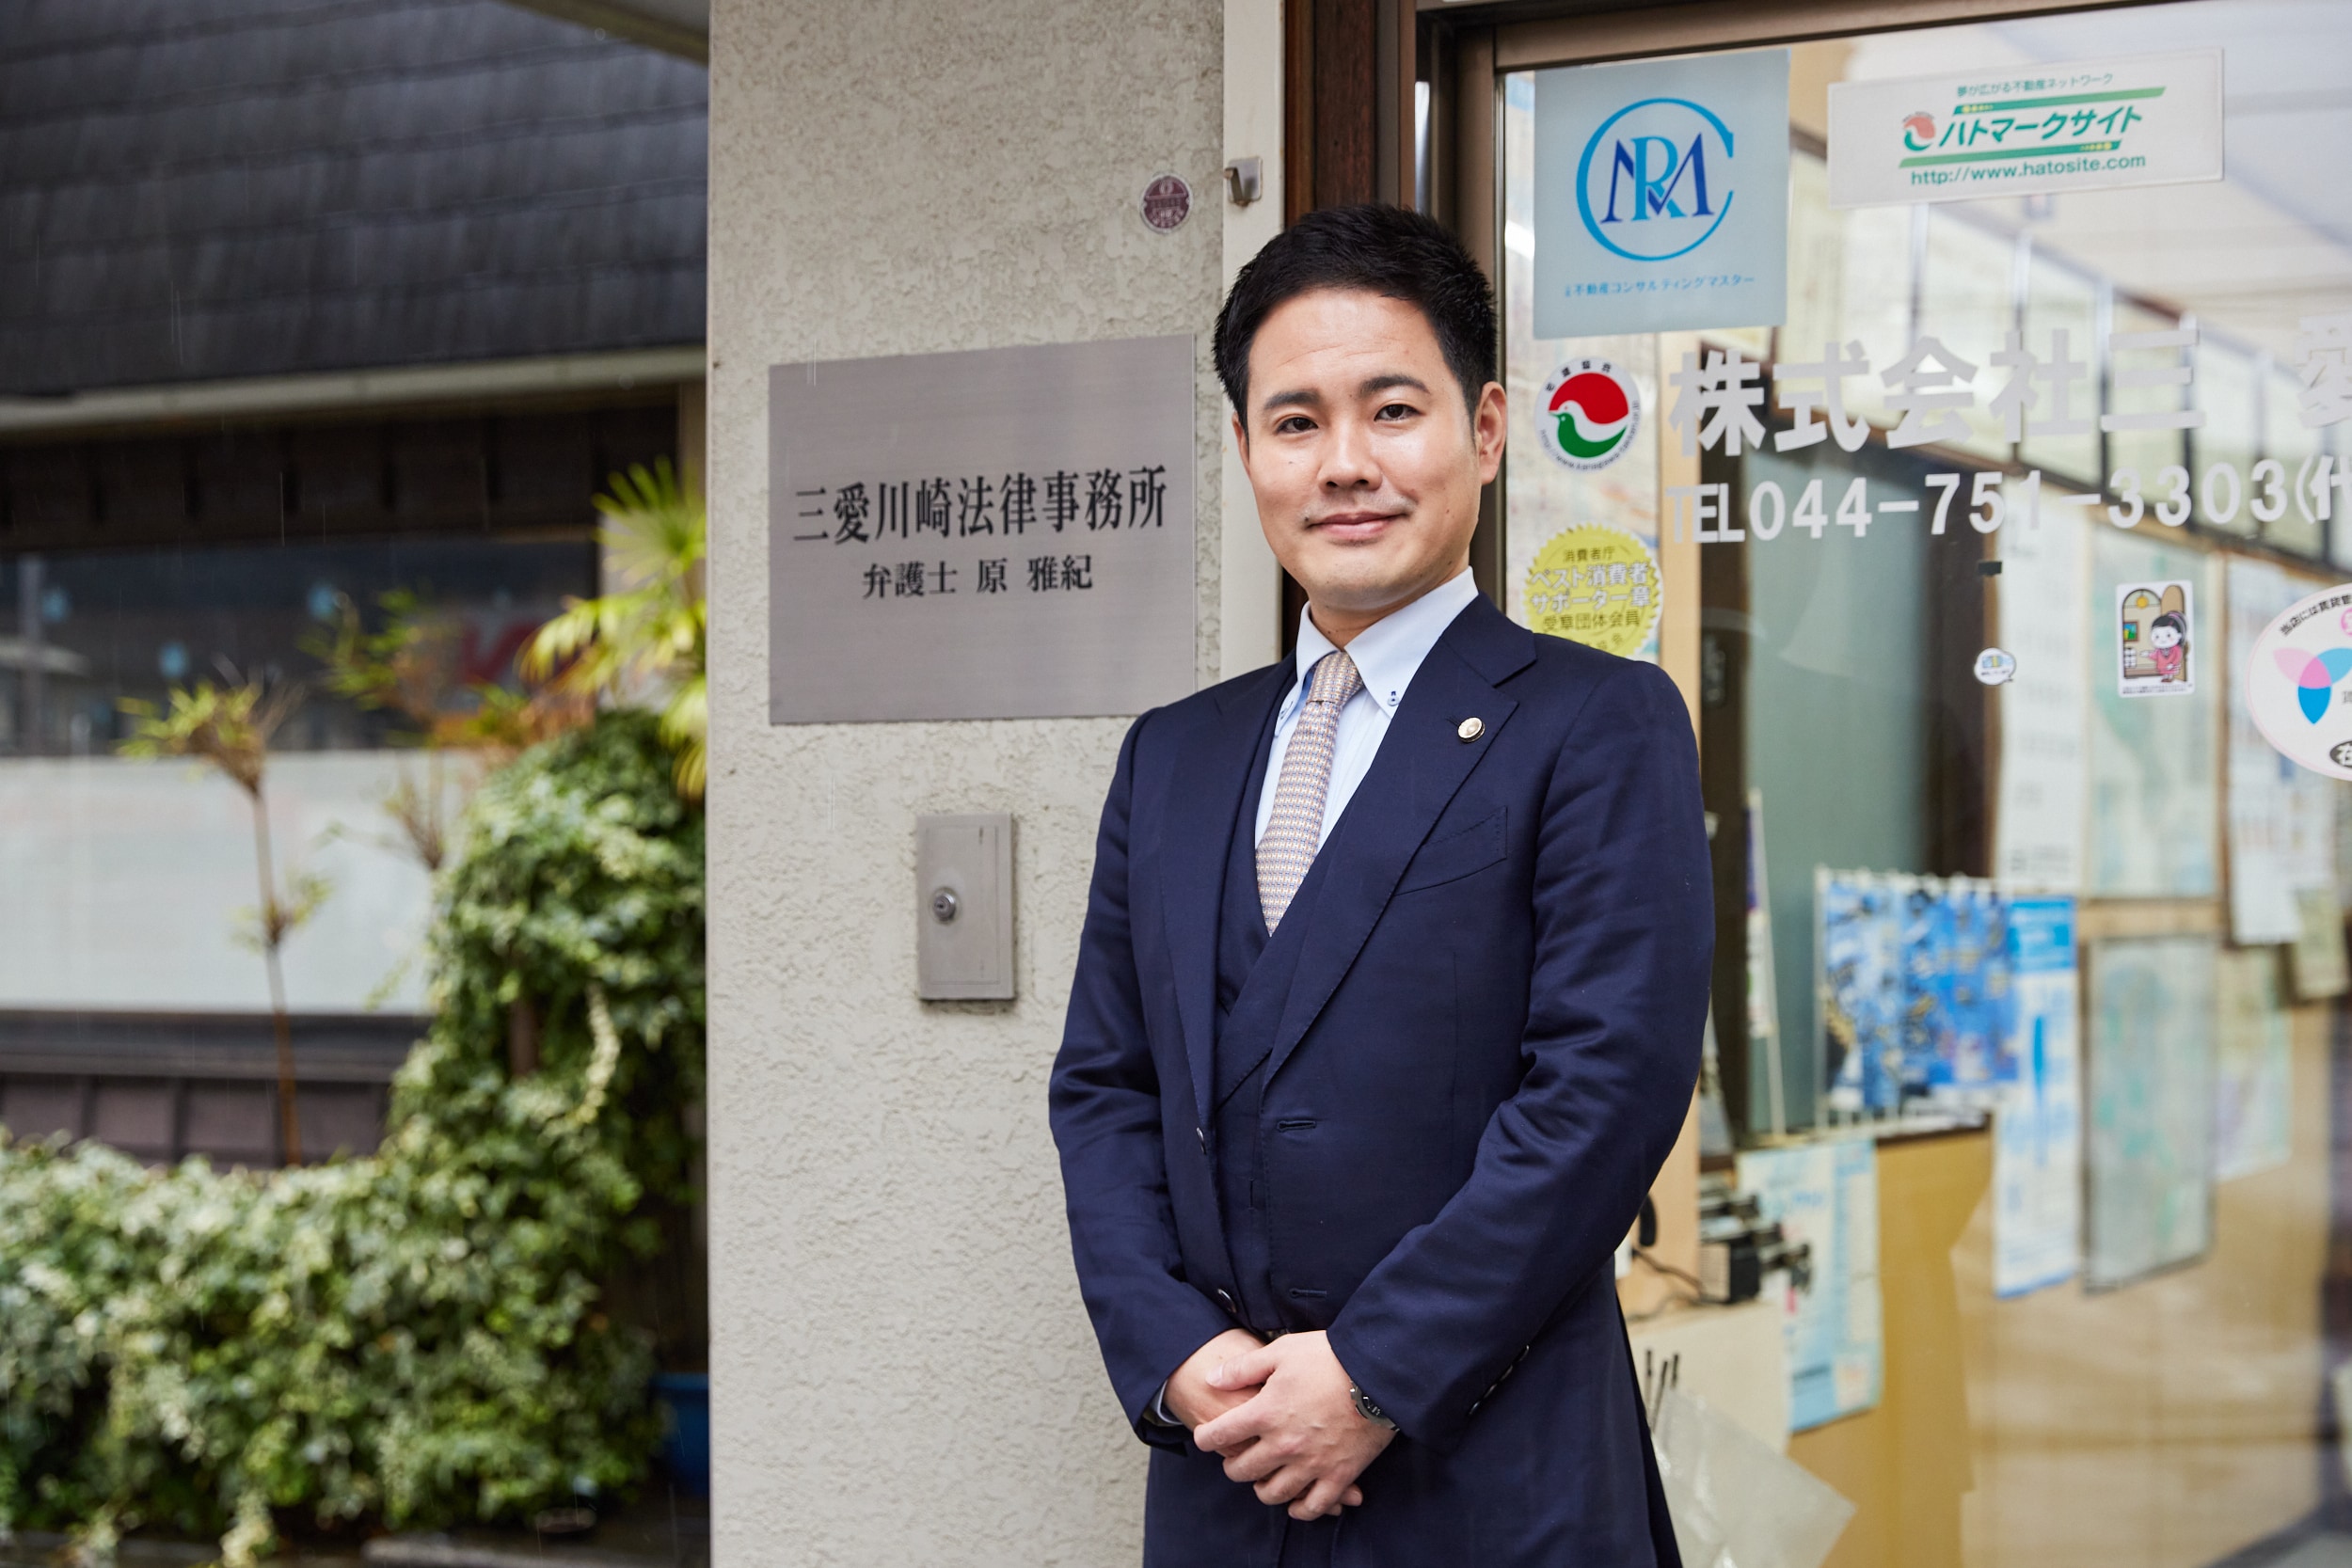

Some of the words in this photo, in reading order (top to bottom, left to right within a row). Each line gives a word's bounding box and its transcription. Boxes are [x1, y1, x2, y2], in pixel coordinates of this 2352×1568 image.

[1957, 73, 2114, 97] 夢が広がる不動産ネットワーク
[1939, 105, 2142, 148] ハトマークサイト
[1911, 155, 2146, 185] http://www.hatosite.com
[793, 465, 1168, 546] 三愛川崎法律事務所
[1564, 546, 1615, 562] 消費者庁
[862, 562, 958, 600] 弁護士
[976, 558, 1009, 595] 原
[1026, 554, 1094, 594] 雅紀
